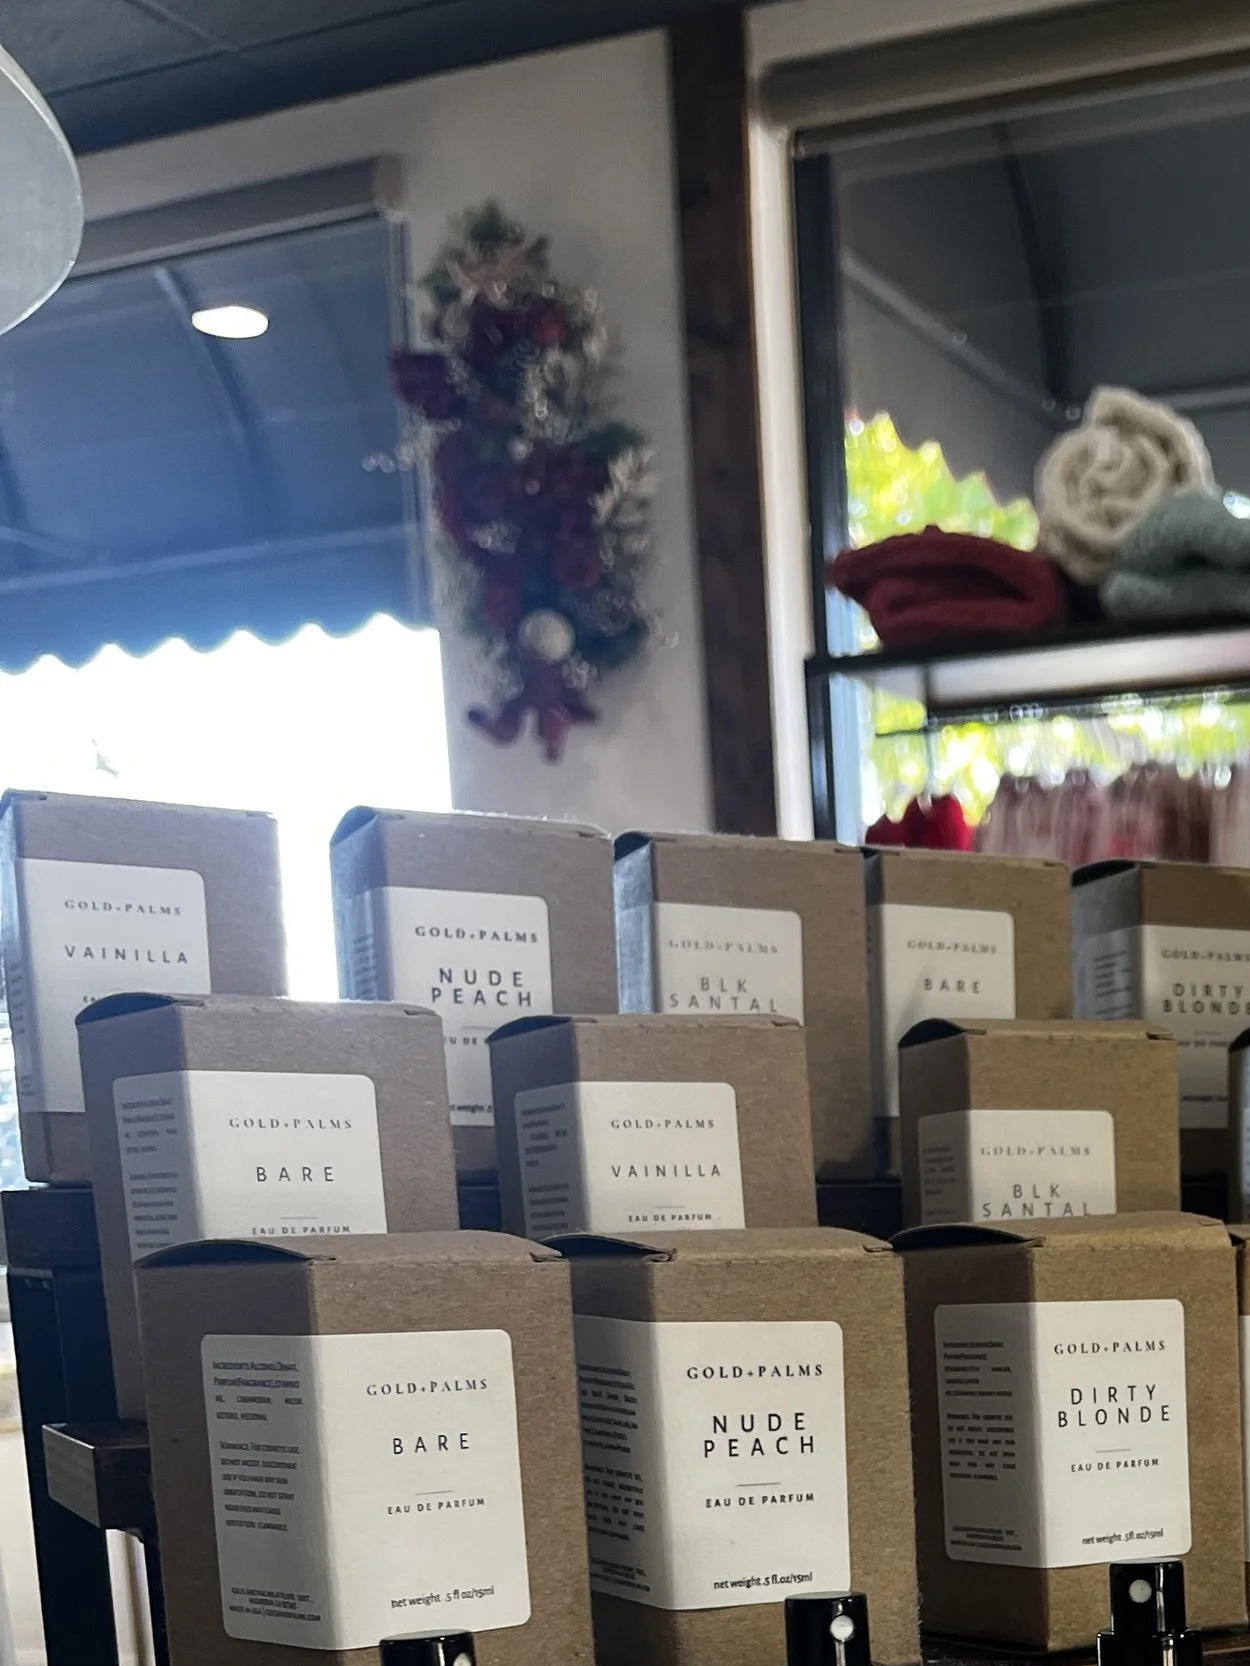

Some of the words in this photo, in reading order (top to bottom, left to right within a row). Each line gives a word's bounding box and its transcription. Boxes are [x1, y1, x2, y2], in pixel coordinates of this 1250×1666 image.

[64, 945, 189, 964] VAINILLA
[439, 967, 524, 987] NUDE
[700, 976, 747, 993] BLK
[924, 978, 981, 994] BARE
[1173, 983, 1244, 998] DIRTY
[431, 987, 532, 1007] PEACH
[669, 993, 778, 1013] SANTAL
[256, 1166, 334, 1182] BARE
[611, 1164, 721, 1178] VAINILLA
[1013, 1183, 1061, 1199] BLK
[628, 1214, 649, 1222] EAU
[653, 1214, 666, 1222] DE
[671, 1213, 712, 1221] PARFUM
[982, 1202, 1091, 1218] SANTAL
[282, 1226, 296, 1234] DE
[303, 1225, 350, 1234] PARFUM
[1071, 1384, 1156, 1405] DIRTY
[713, 1412, 806, 1433] NUDE
[1058, 1405, 1170, 1427] BLONDE
[393, 1433, 470, 1454] BARE
[703, 1436, 815, 1458] PEACH
[1071, 1463, 1092, 1472] EAU
[1097, 1461, 1111, 1471] DE
[1116, 1458, 1159, 1469] PARFUM
[387, 1504, 411, 1515] EAU
[417, 1502, 431, 1512] DE
[438, 1498, 485, 1510] PARFUM
[706, 1498, 731, 1508] EAU
[738, 1496, 755, 1506] DE
[762, 1493, 814, 1505] PARFUM
